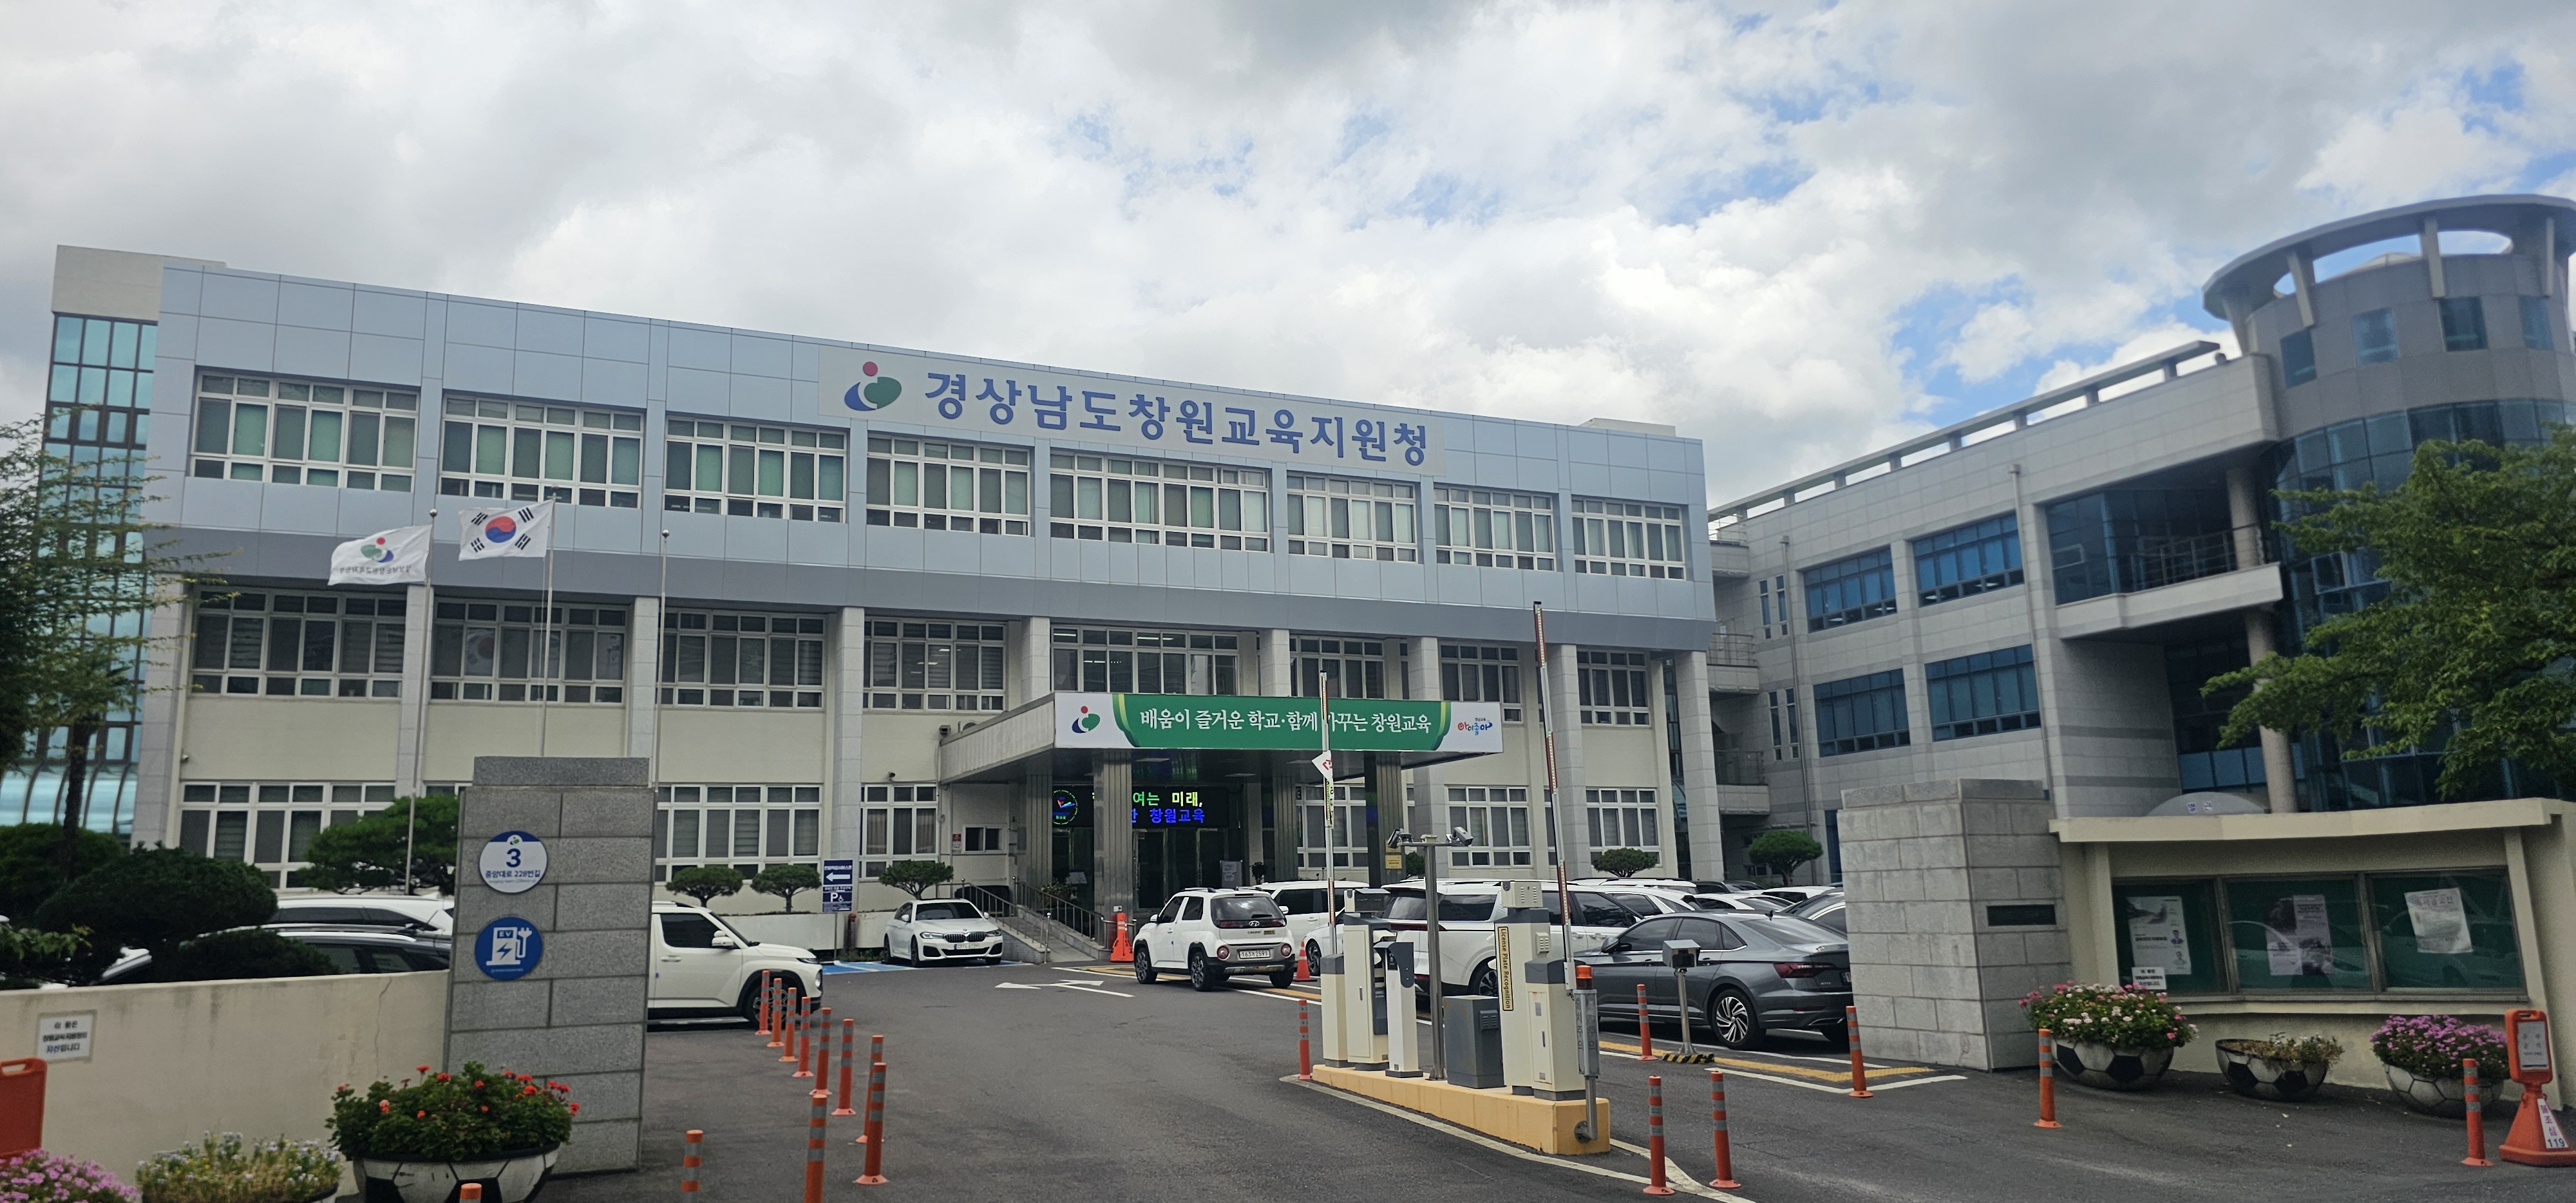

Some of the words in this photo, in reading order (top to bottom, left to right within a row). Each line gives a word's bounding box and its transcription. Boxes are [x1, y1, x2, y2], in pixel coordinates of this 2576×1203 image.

[925, 373, 1426, 466] 경상남도창원교육지원청
[1139, 708, 1190, 730] 배움이
[1194, 709, 1245, 730] 즐거운
[1371, 712, 1432, 734] 창원교육
[1171, 791, 1203, 808] 미래,
[1150, 808, 1205, 824] 창원교육
[506, 848, 521, 867] 3
[831, 892, 838, 902] P
[2548, 1138, 2565, 1147] 119
